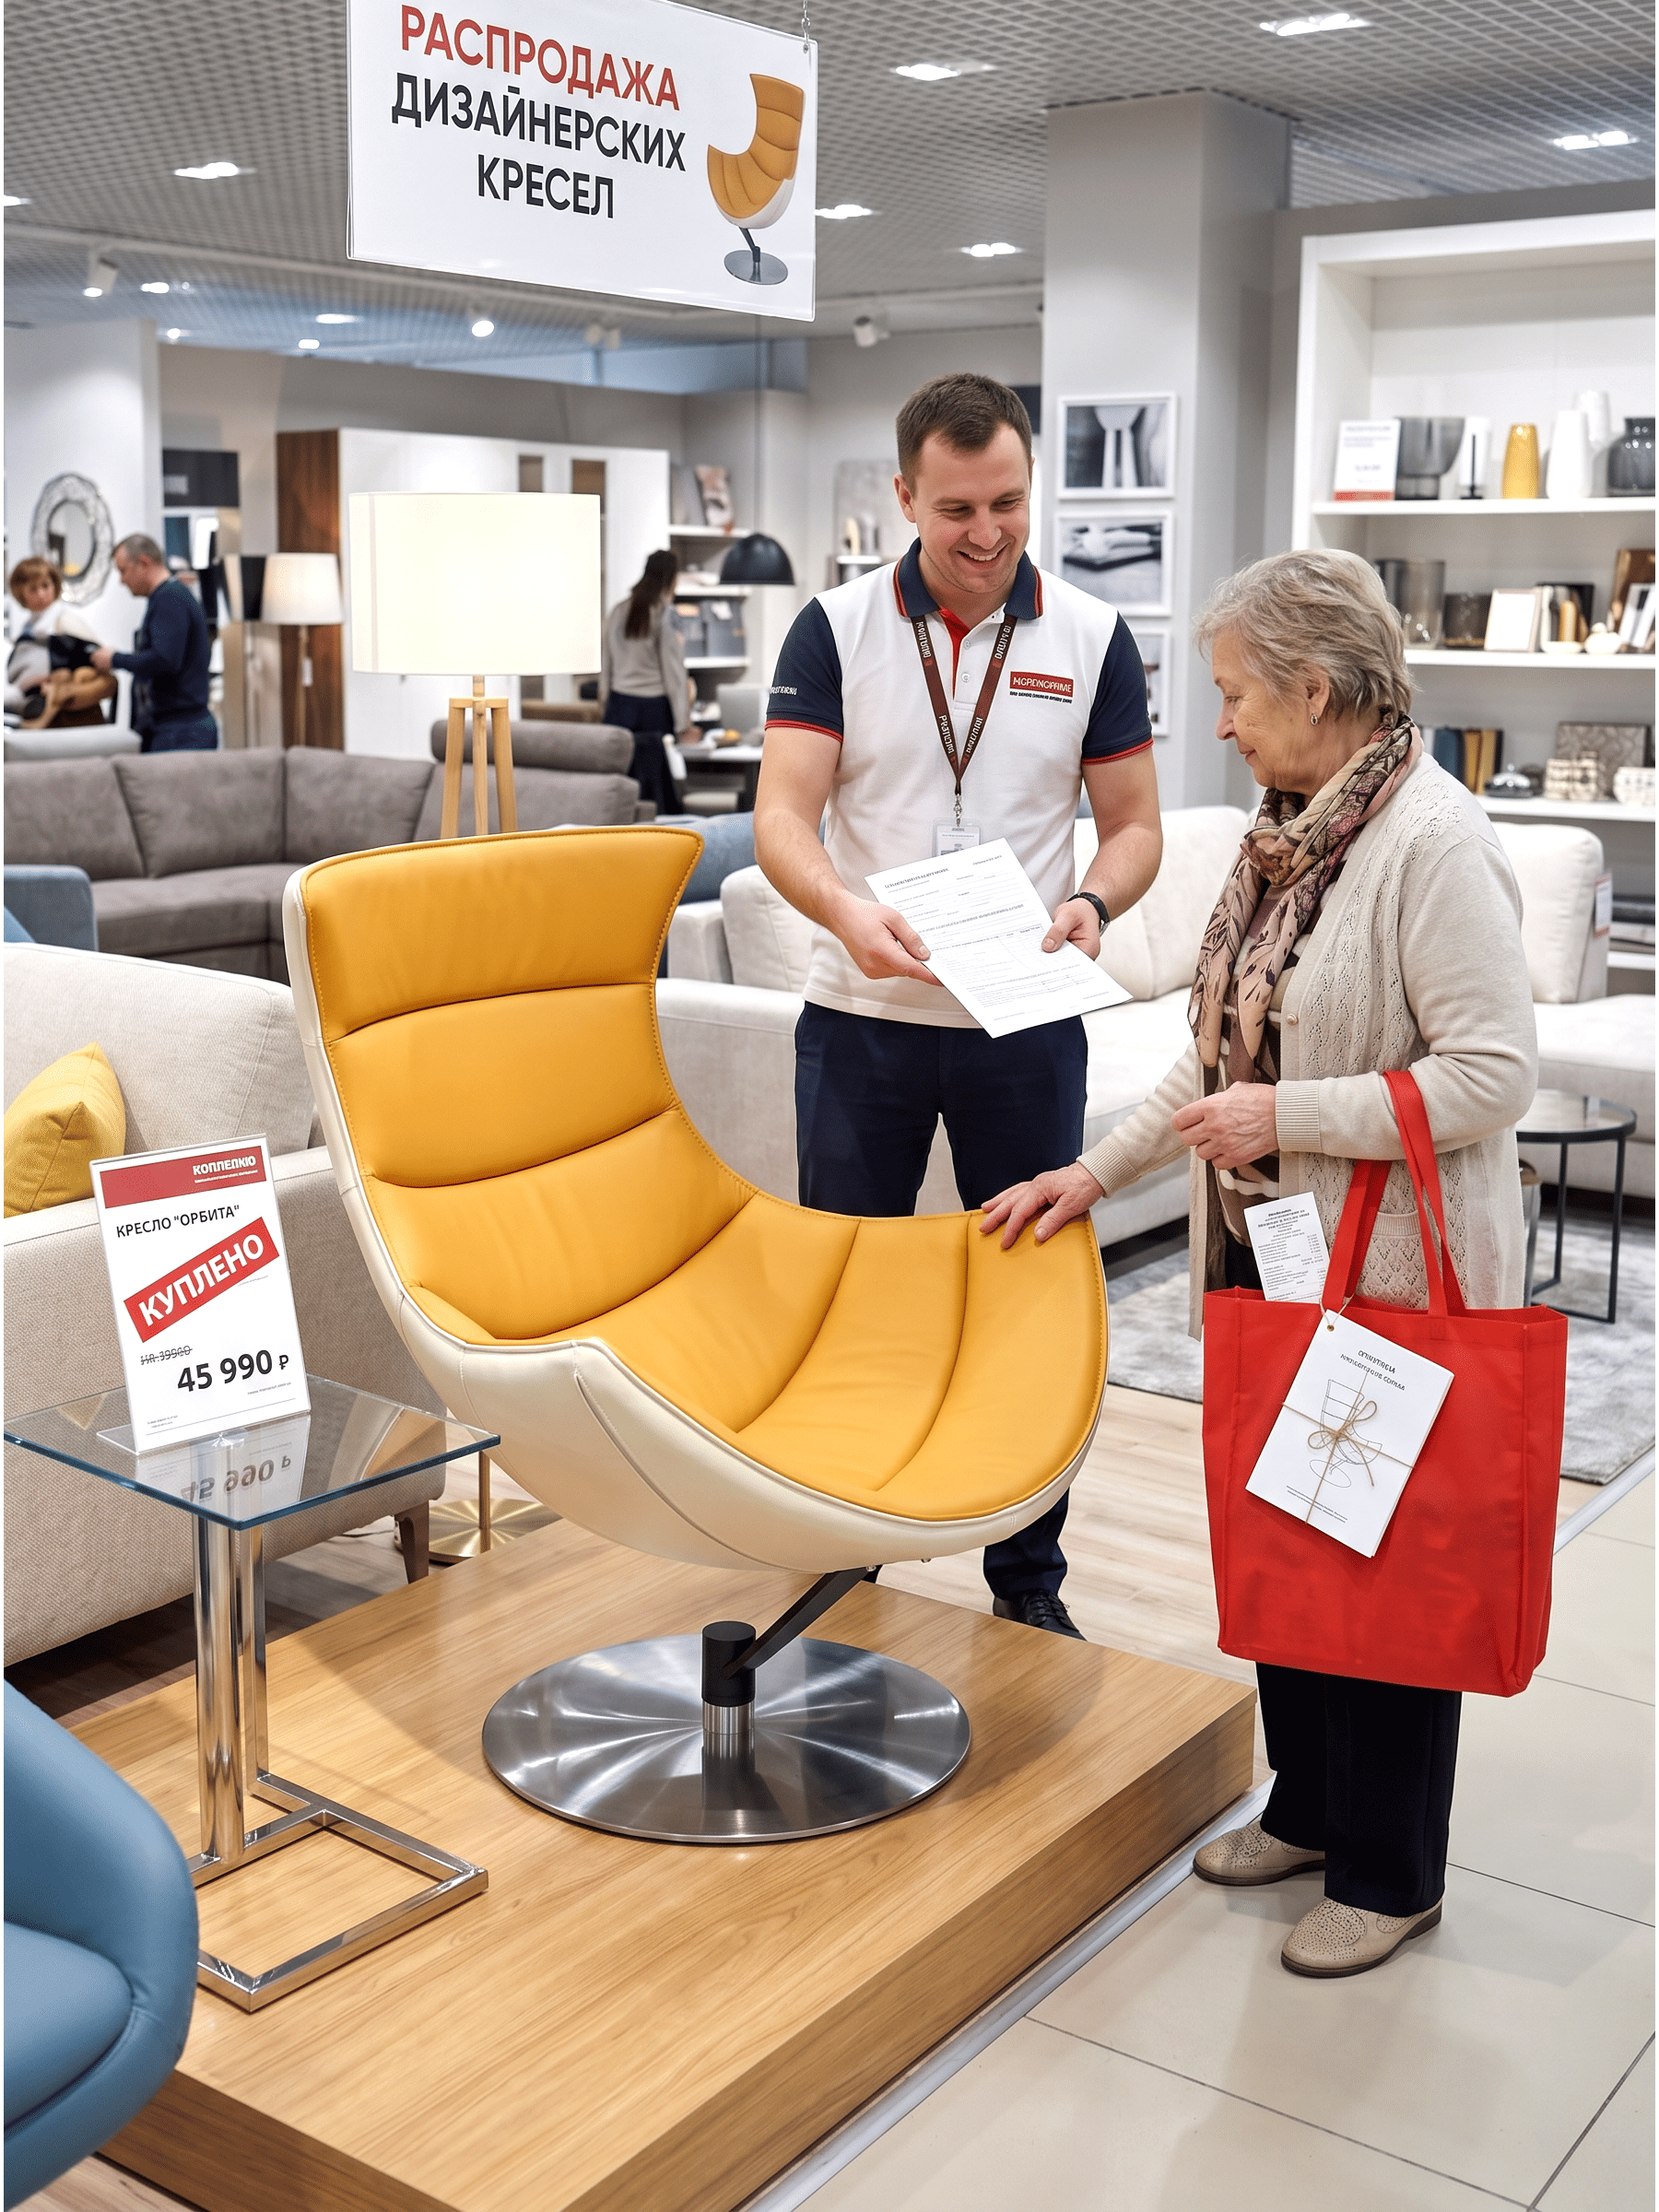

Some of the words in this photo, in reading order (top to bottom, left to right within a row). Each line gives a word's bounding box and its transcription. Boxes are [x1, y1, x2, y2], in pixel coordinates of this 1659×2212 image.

[401, 5, 680, 111] РАСПРОДАЖА
[392, 72, 687, 172] ДИЗАЙНЕРСКИХ
[477, 154, 614, 219] КРЕСЕЛ
[116, 1217, 172, 1239] КРЕСЛО
[173, 1204, 241, 1227] "ОРБИТА"
[138, 1233, 265, 1327] КУПЛЕНО
[177, 1362, 213, 1393] 45
[219, 1349, 273, 1384] 990
